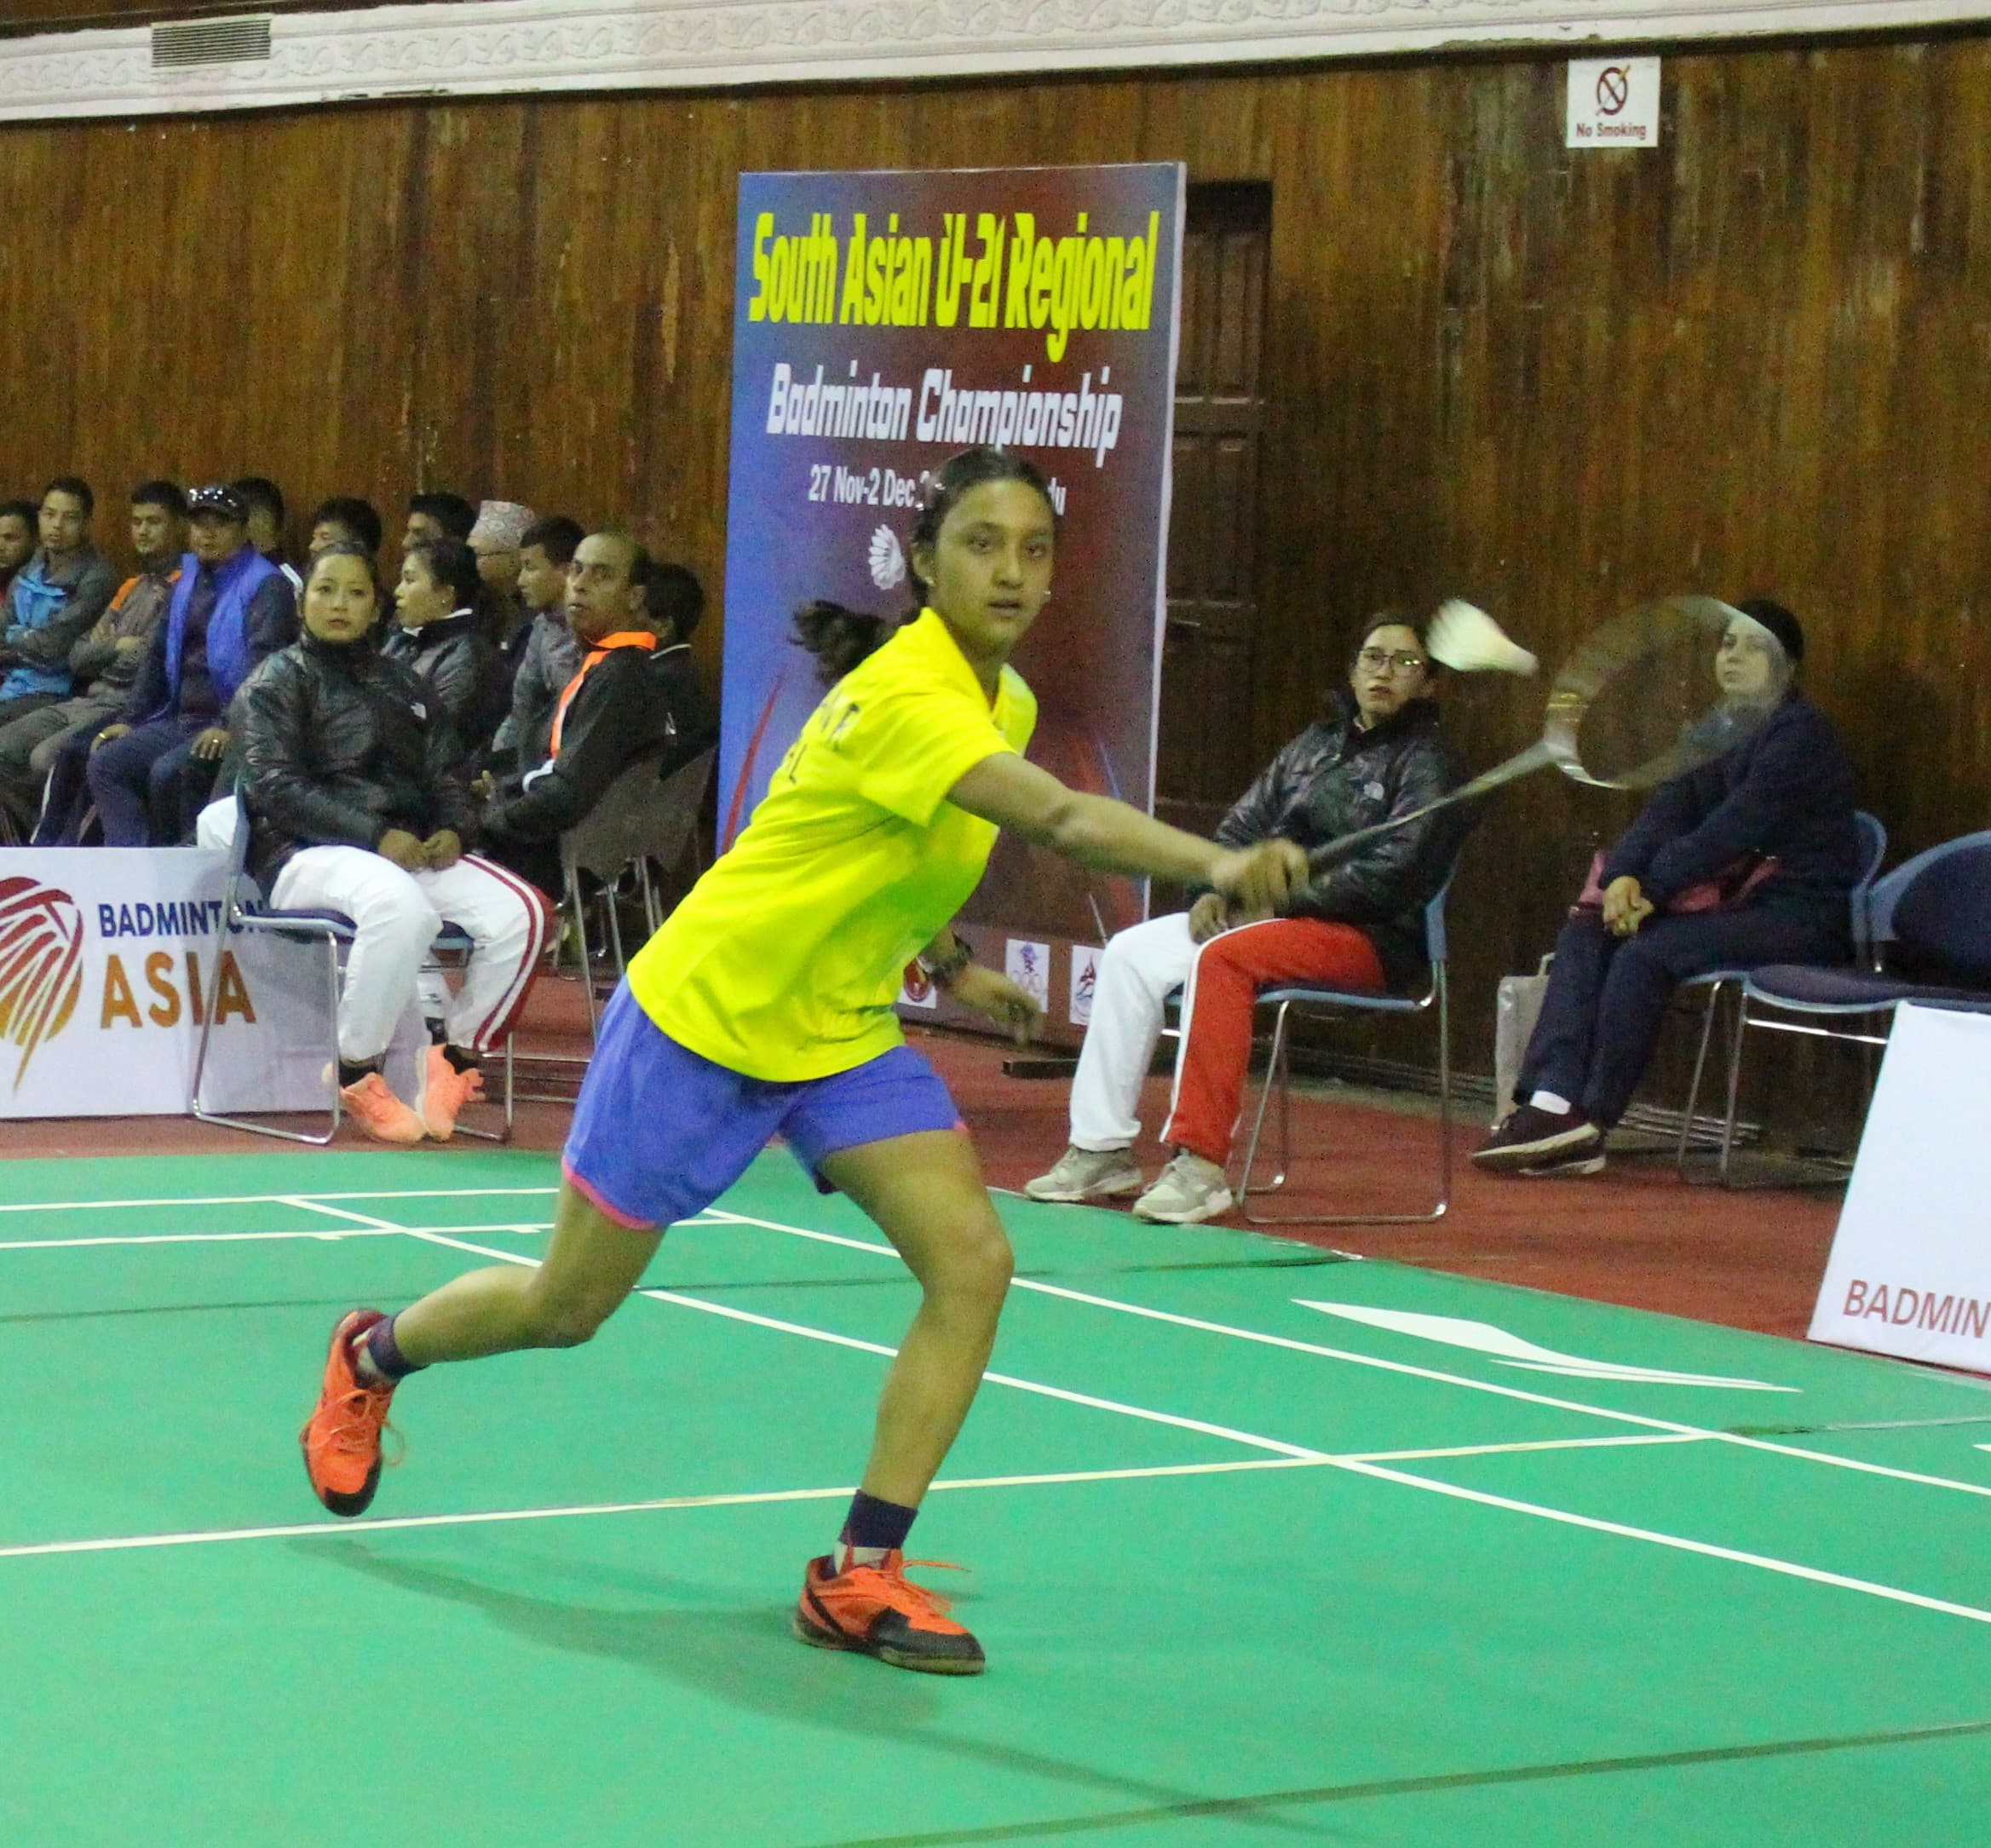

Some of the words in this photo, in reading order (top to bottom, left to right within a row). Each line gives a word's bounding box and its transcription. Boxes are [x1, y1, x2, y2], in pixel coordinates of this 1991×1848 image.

[1576, 123, 1592, 137] No
[1597, 122, 1646, 141] Smoking
[748, 212, 837, 324] South
[839, 212, 932, 326] Asian
[935, 212, 1006, 328] U-21
[1004, 210, 1159, 363] Regional
[766, 360, 912, 440] Badminton
[915, 365, 1123, 469] Championship
[808, 464, 832, 502] 27
[834, 466, 881, 505] Nov-2
[101, 950, 256, 1029] ASIA
[1843, 1279, 1991, 1339] BADMIN
